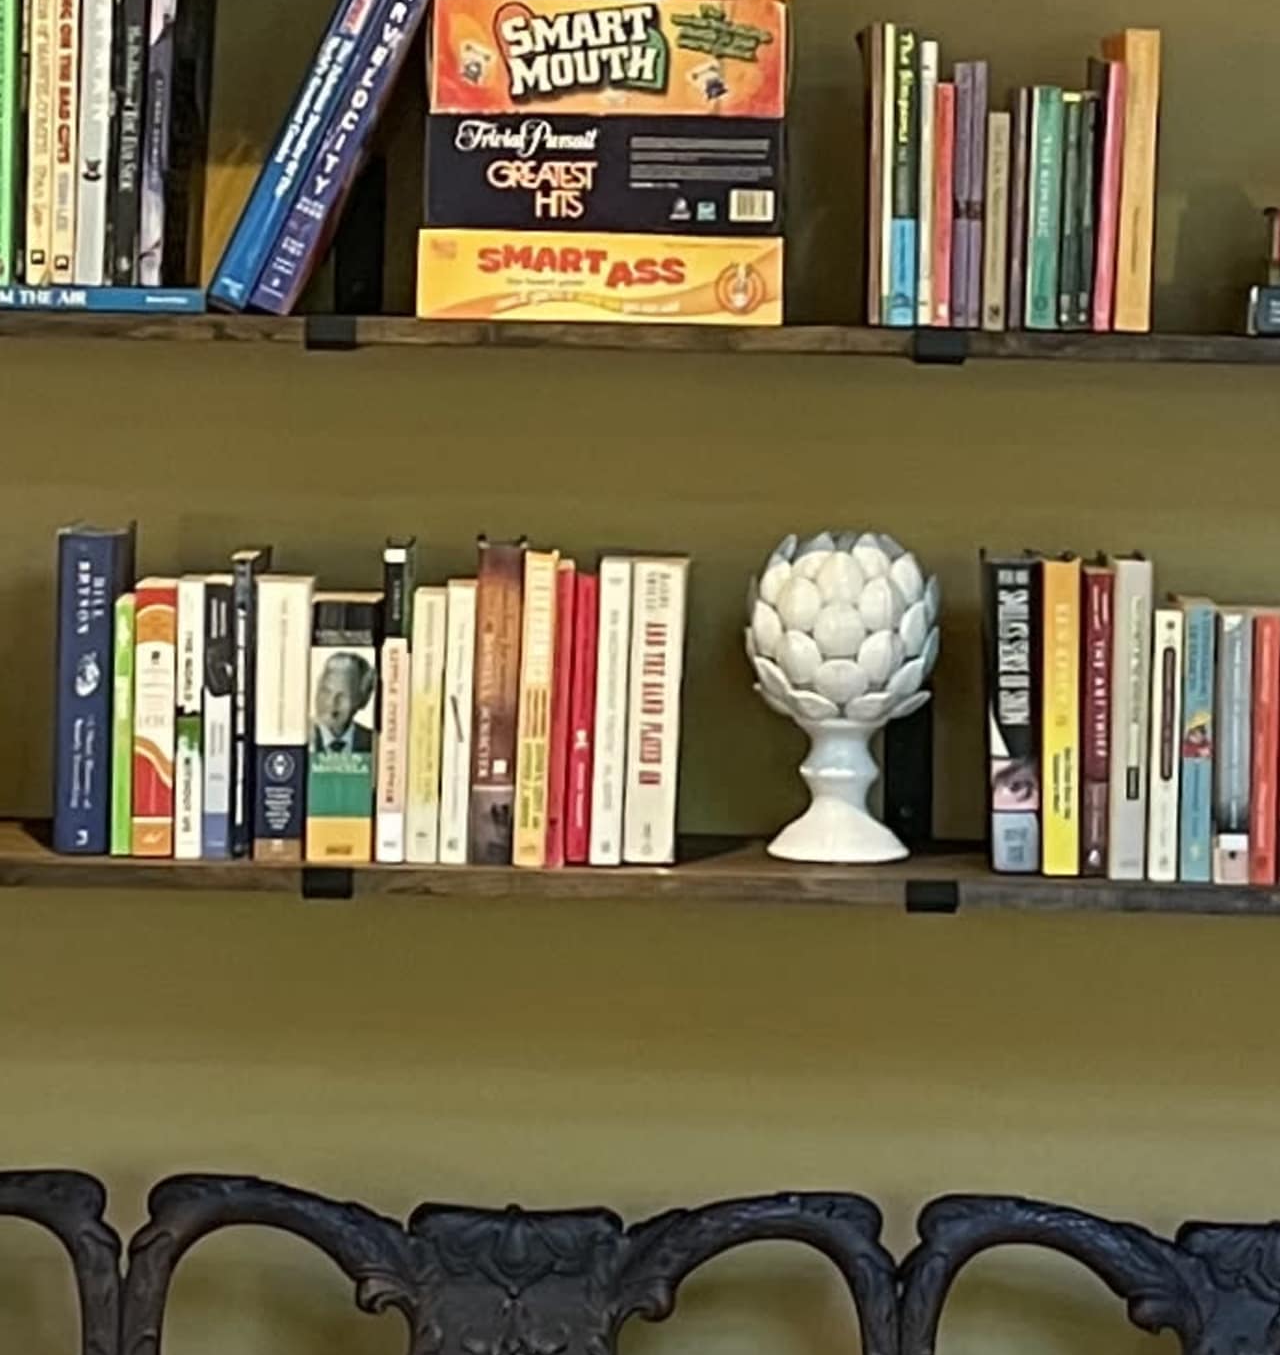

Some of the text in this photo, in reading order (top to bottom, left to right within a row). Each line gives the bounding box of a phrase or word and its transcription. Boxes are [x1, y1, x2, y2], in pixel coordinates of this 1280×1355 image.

[501, 5, 654, 55] SMART
[899, 31, 915, 65] The
[510, 46, 658, 95] MOUTH
[58, 85, 71, 122] BAD
[898, 69, 914, 143] Simpsons
[57, 123, 71, 165] GUYS
[455, 118, 600, 158] Trivial Pursuit
[487, 160, 598, 190] GREATEST
[535, 190, 584, 219] HITS
[477, 245, 687, 288] SMART ASS
[19, 289, 53, 306] THE
[56, 290, 87, 306] AIR
[76, 559, 91, 635] BRYSON
[92, 577, 106, 617] BILL
[644, 621, 669, 645] AND
[183, 629, 195, 702] THE WORLD
[641, 651, 668, 677] THE
[640, 681, 666, 715] BAND
[639, 721, 664, 765] PLAYED
[181, 755, 193, 833] WITHOUT US
